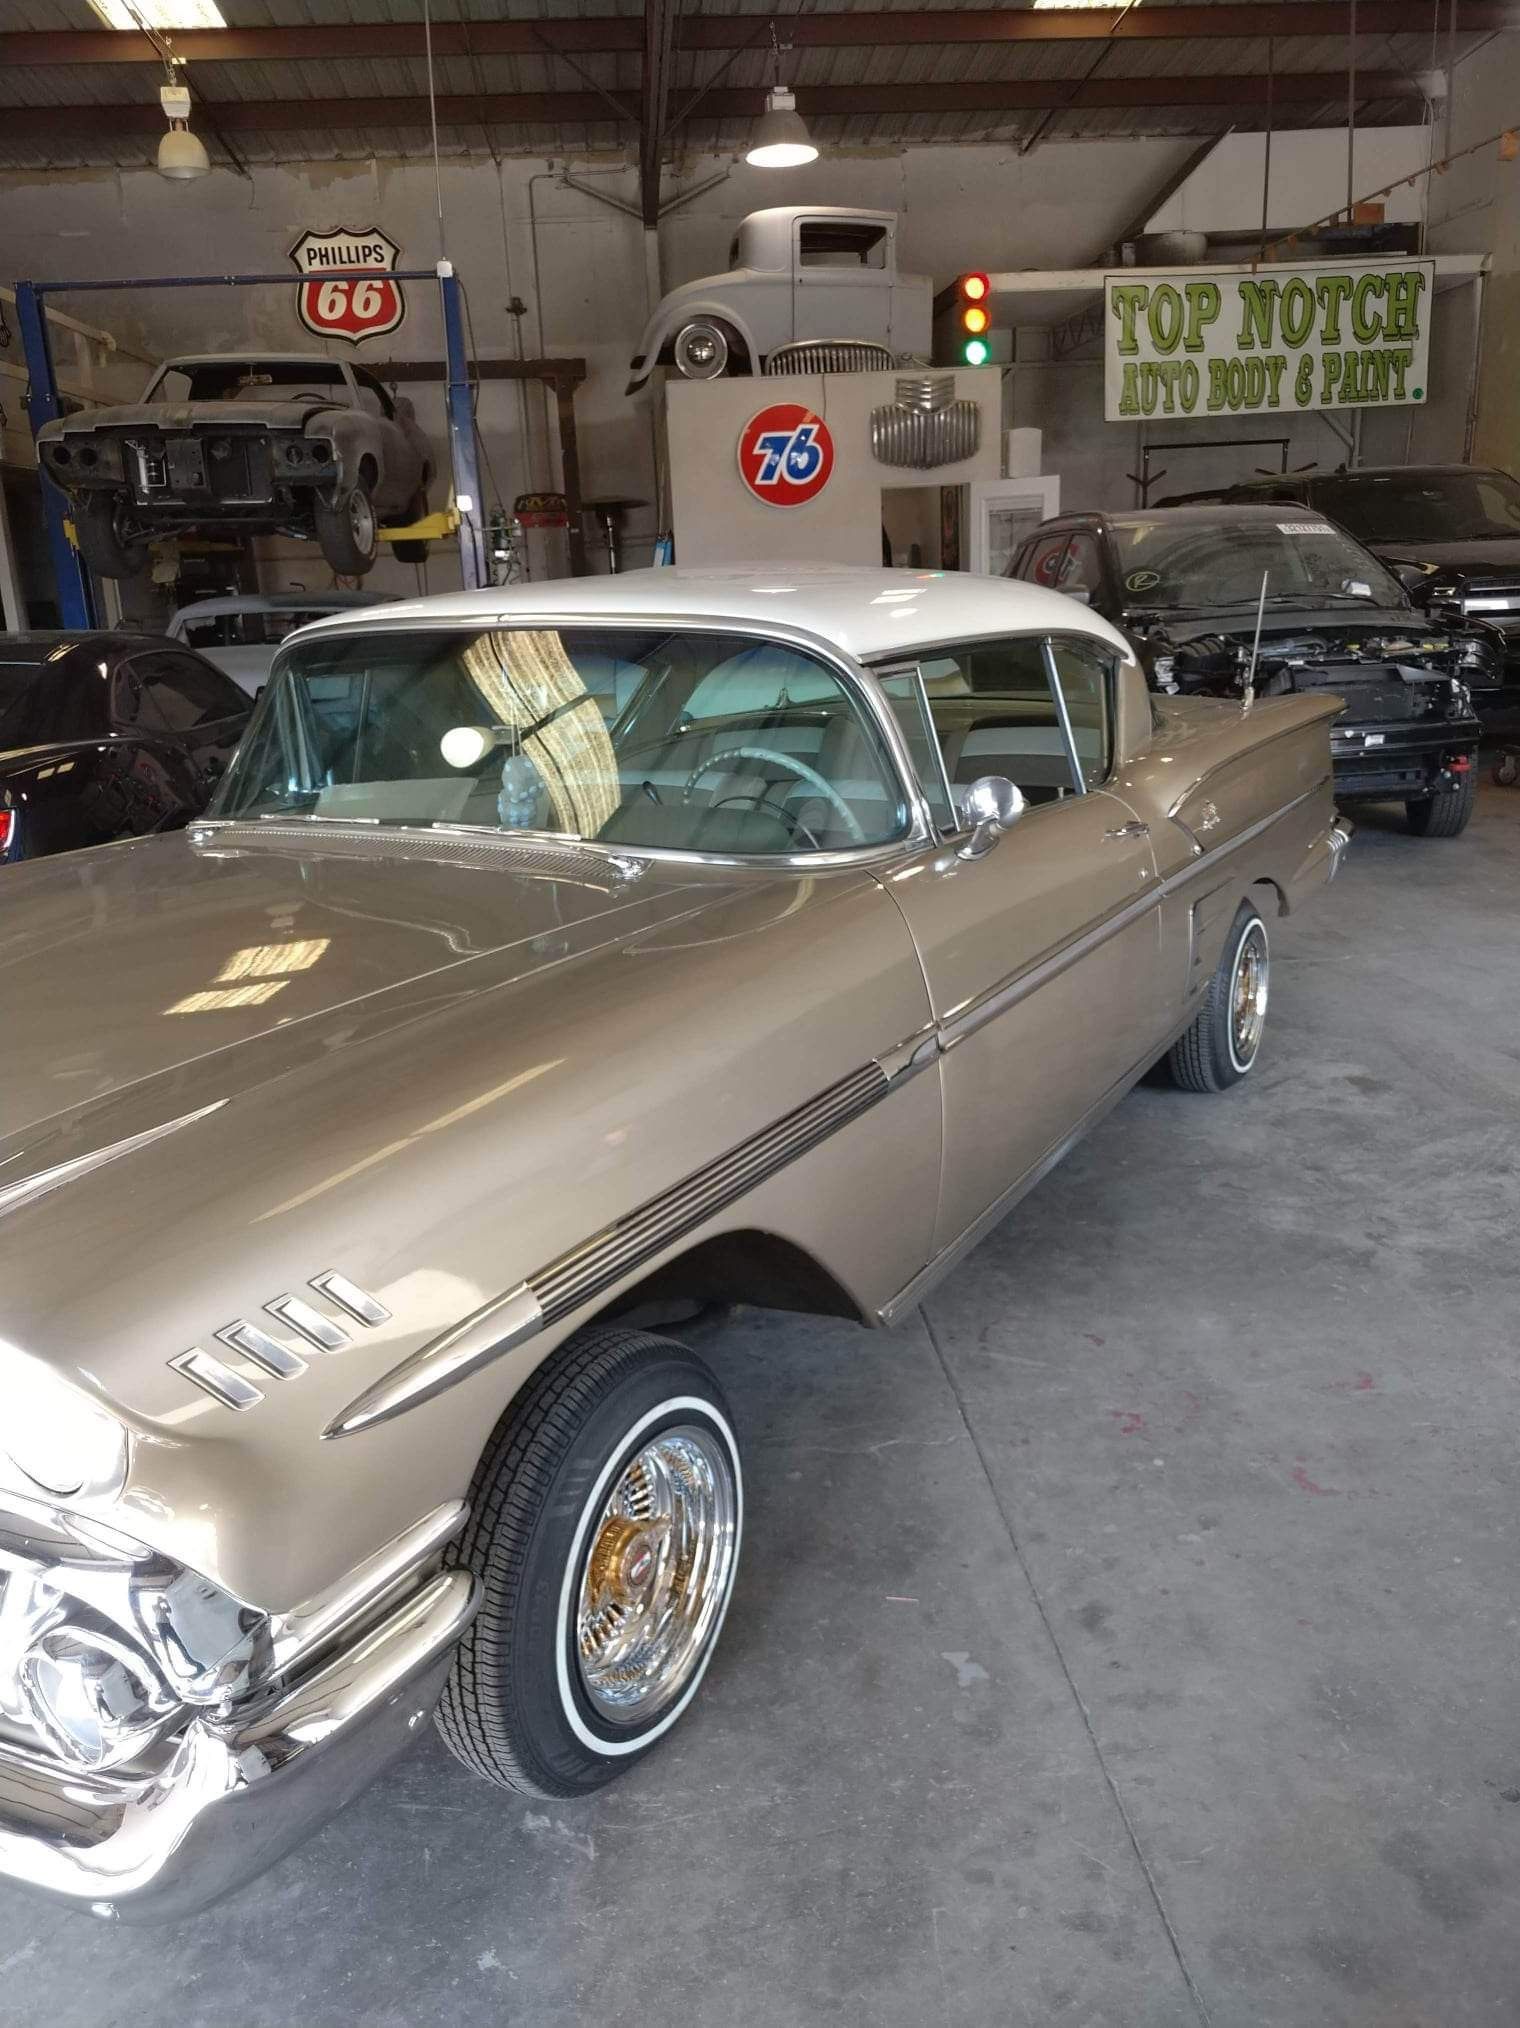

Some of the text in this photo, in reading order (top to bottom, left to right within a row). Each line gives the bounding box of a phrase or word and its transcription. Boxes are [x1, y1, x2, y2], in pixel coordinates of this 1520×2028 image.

[306, 244, 385, 266] PHILLIPS
[317, 279, 384, 321] 66
[1111, 271, 1426, 356] TOP NOTCH
[1119, 358, 1200, 416] AUTO
[1207, 354, 1287, 412] BODY
[1294, 353, 1314, 407] &
[752, 423, 824, 486] 76
